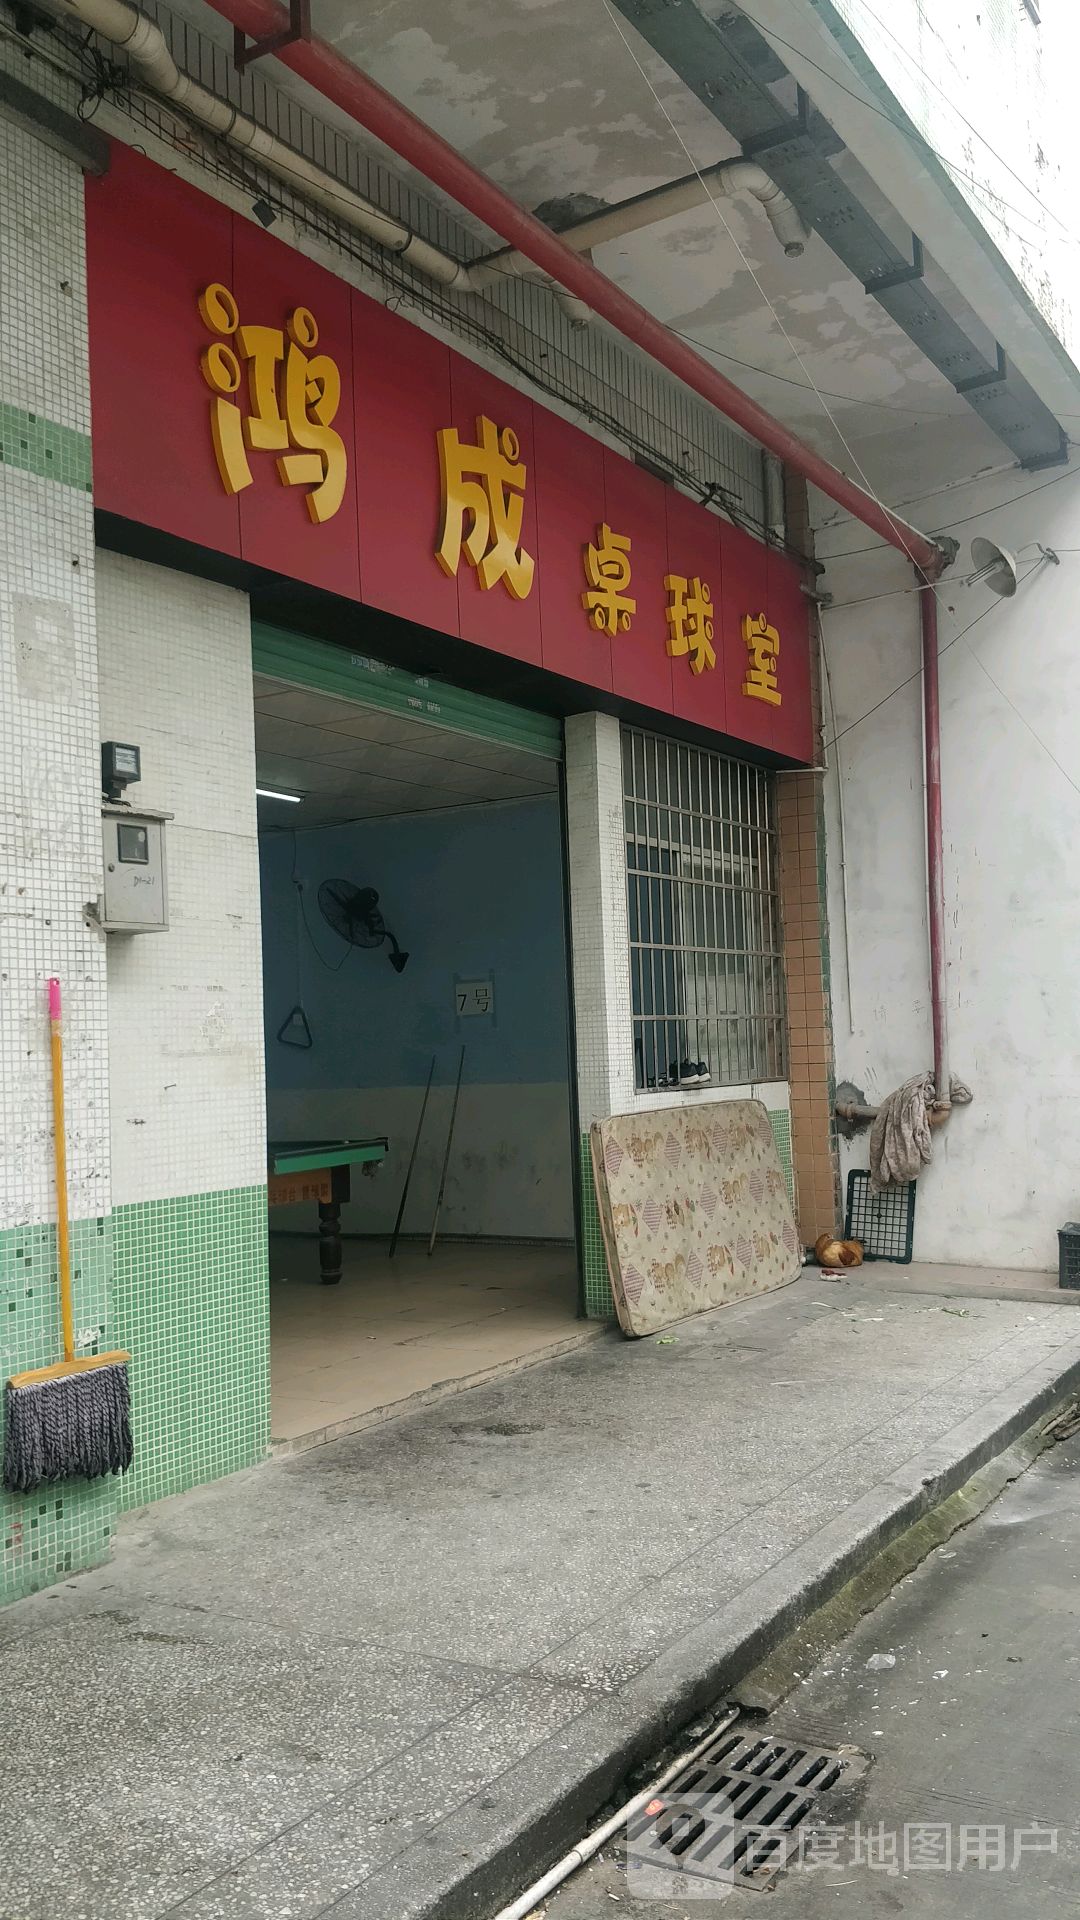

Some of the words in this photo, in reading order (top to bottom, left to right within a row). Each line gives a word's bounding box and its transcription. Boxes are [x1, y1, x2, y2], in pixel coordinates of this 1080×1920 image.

[198, 283, 782, 707] 鸿成桌球室
[457, 988, 491, 1012] 7号
